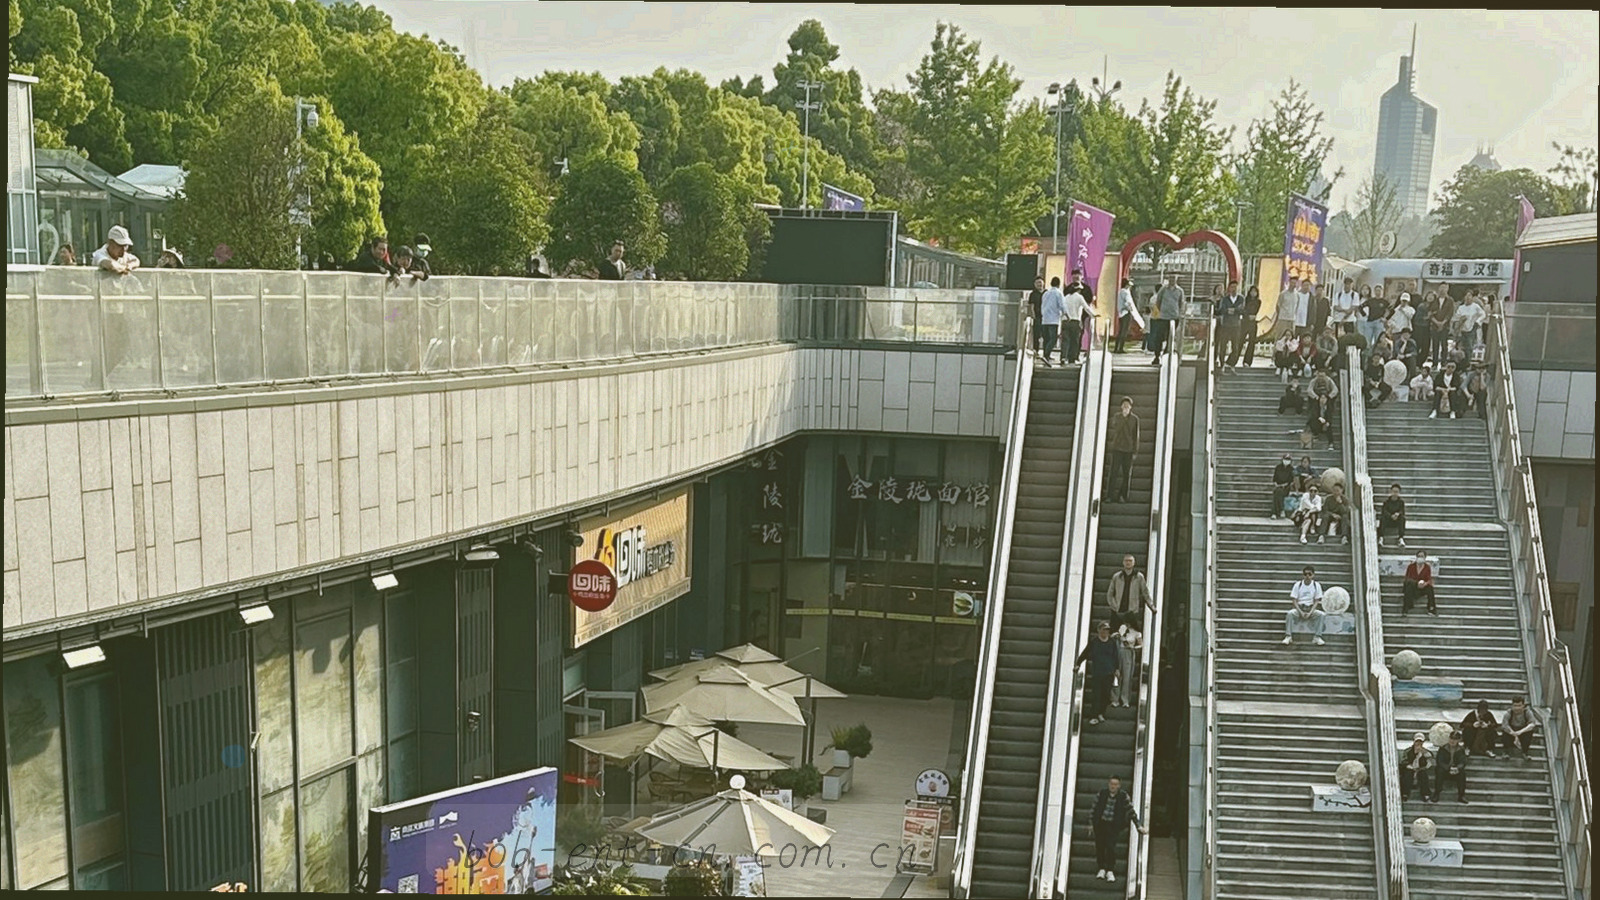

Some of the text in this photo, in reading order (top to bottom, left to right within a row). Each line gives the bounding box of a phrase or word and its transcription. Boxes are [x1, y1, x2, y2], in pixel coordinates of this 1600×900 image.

[1429, 263, 1499, 276] 奇福 汉堡
[573, 573, 611, 592] 回味
